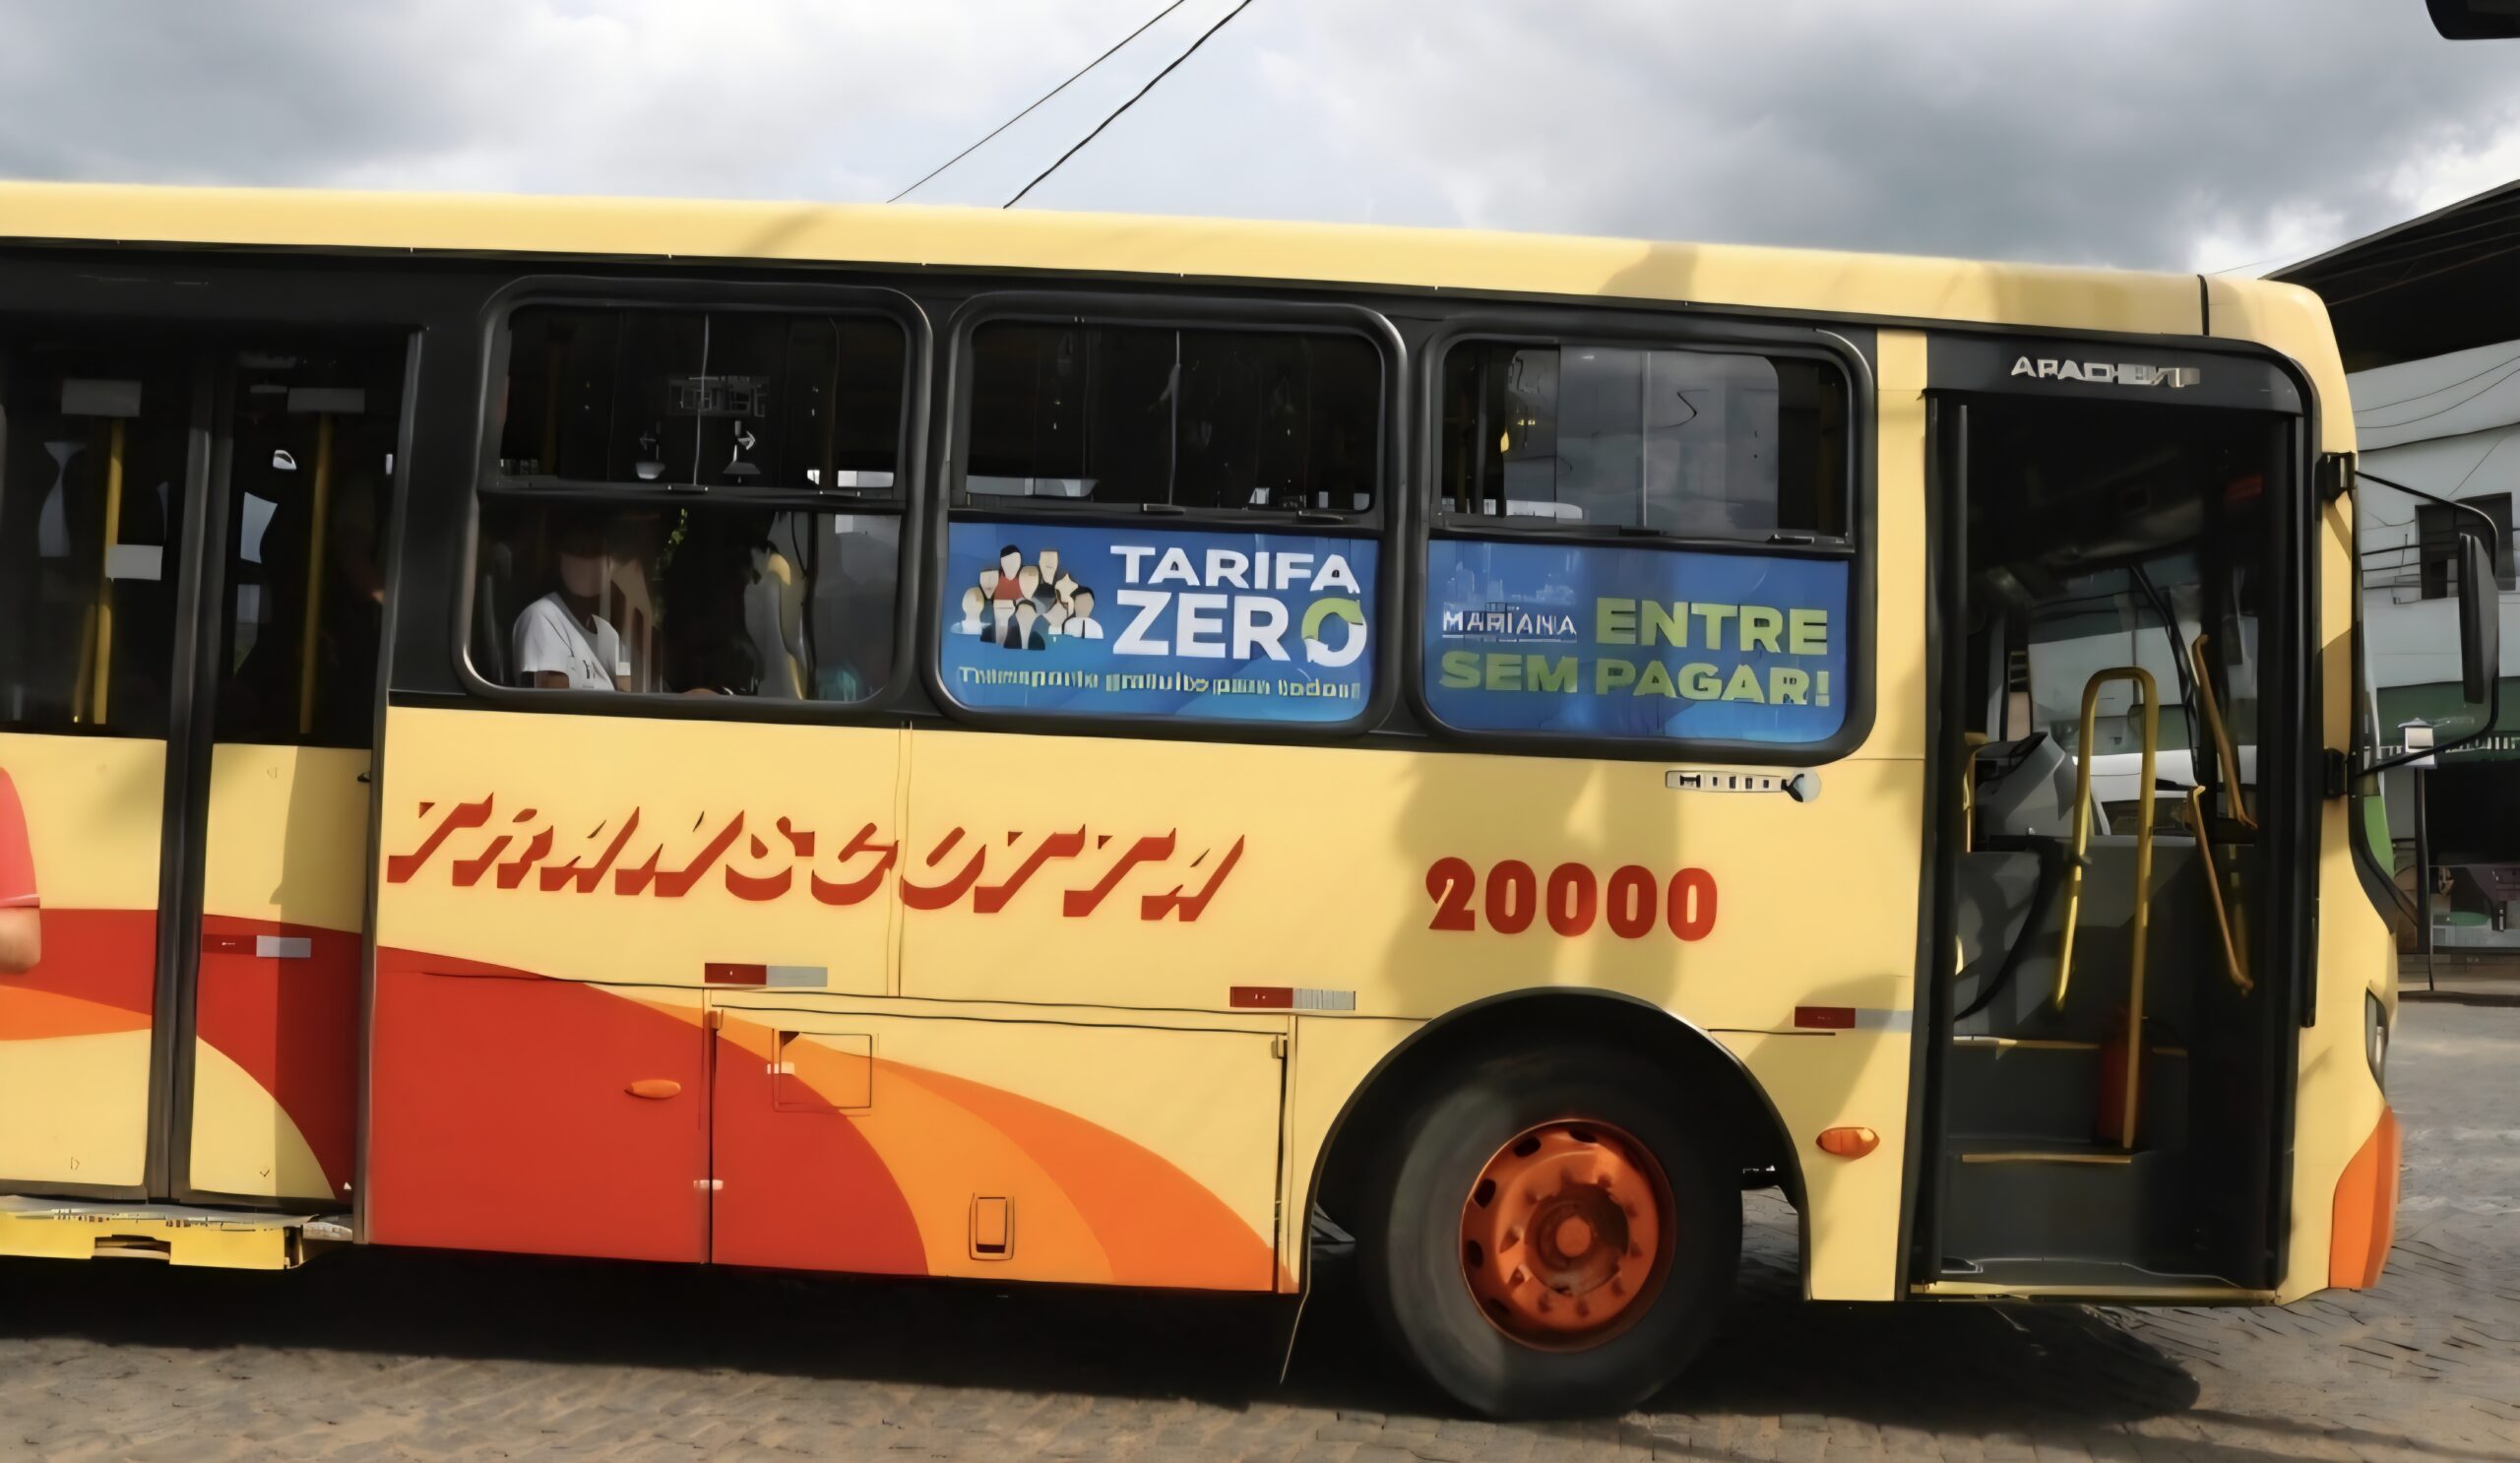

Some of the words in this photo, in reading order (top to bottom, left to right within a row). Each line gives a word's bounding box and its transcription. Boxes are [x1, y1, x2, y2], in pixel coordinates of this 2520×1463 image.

[1109, 544, 1360, 595] TARIFA
[1112, 589, 1368, 668] ZERO
[1596, 597, 1828, 656] ENTRE
[1438, 650, 1578, 694] SEM
[1596, 658, 1831, 708] PAGAR!
[387, 792, 1245, 922] TRANSCOTTA
[1425, 857, 1718, 942] 20000
